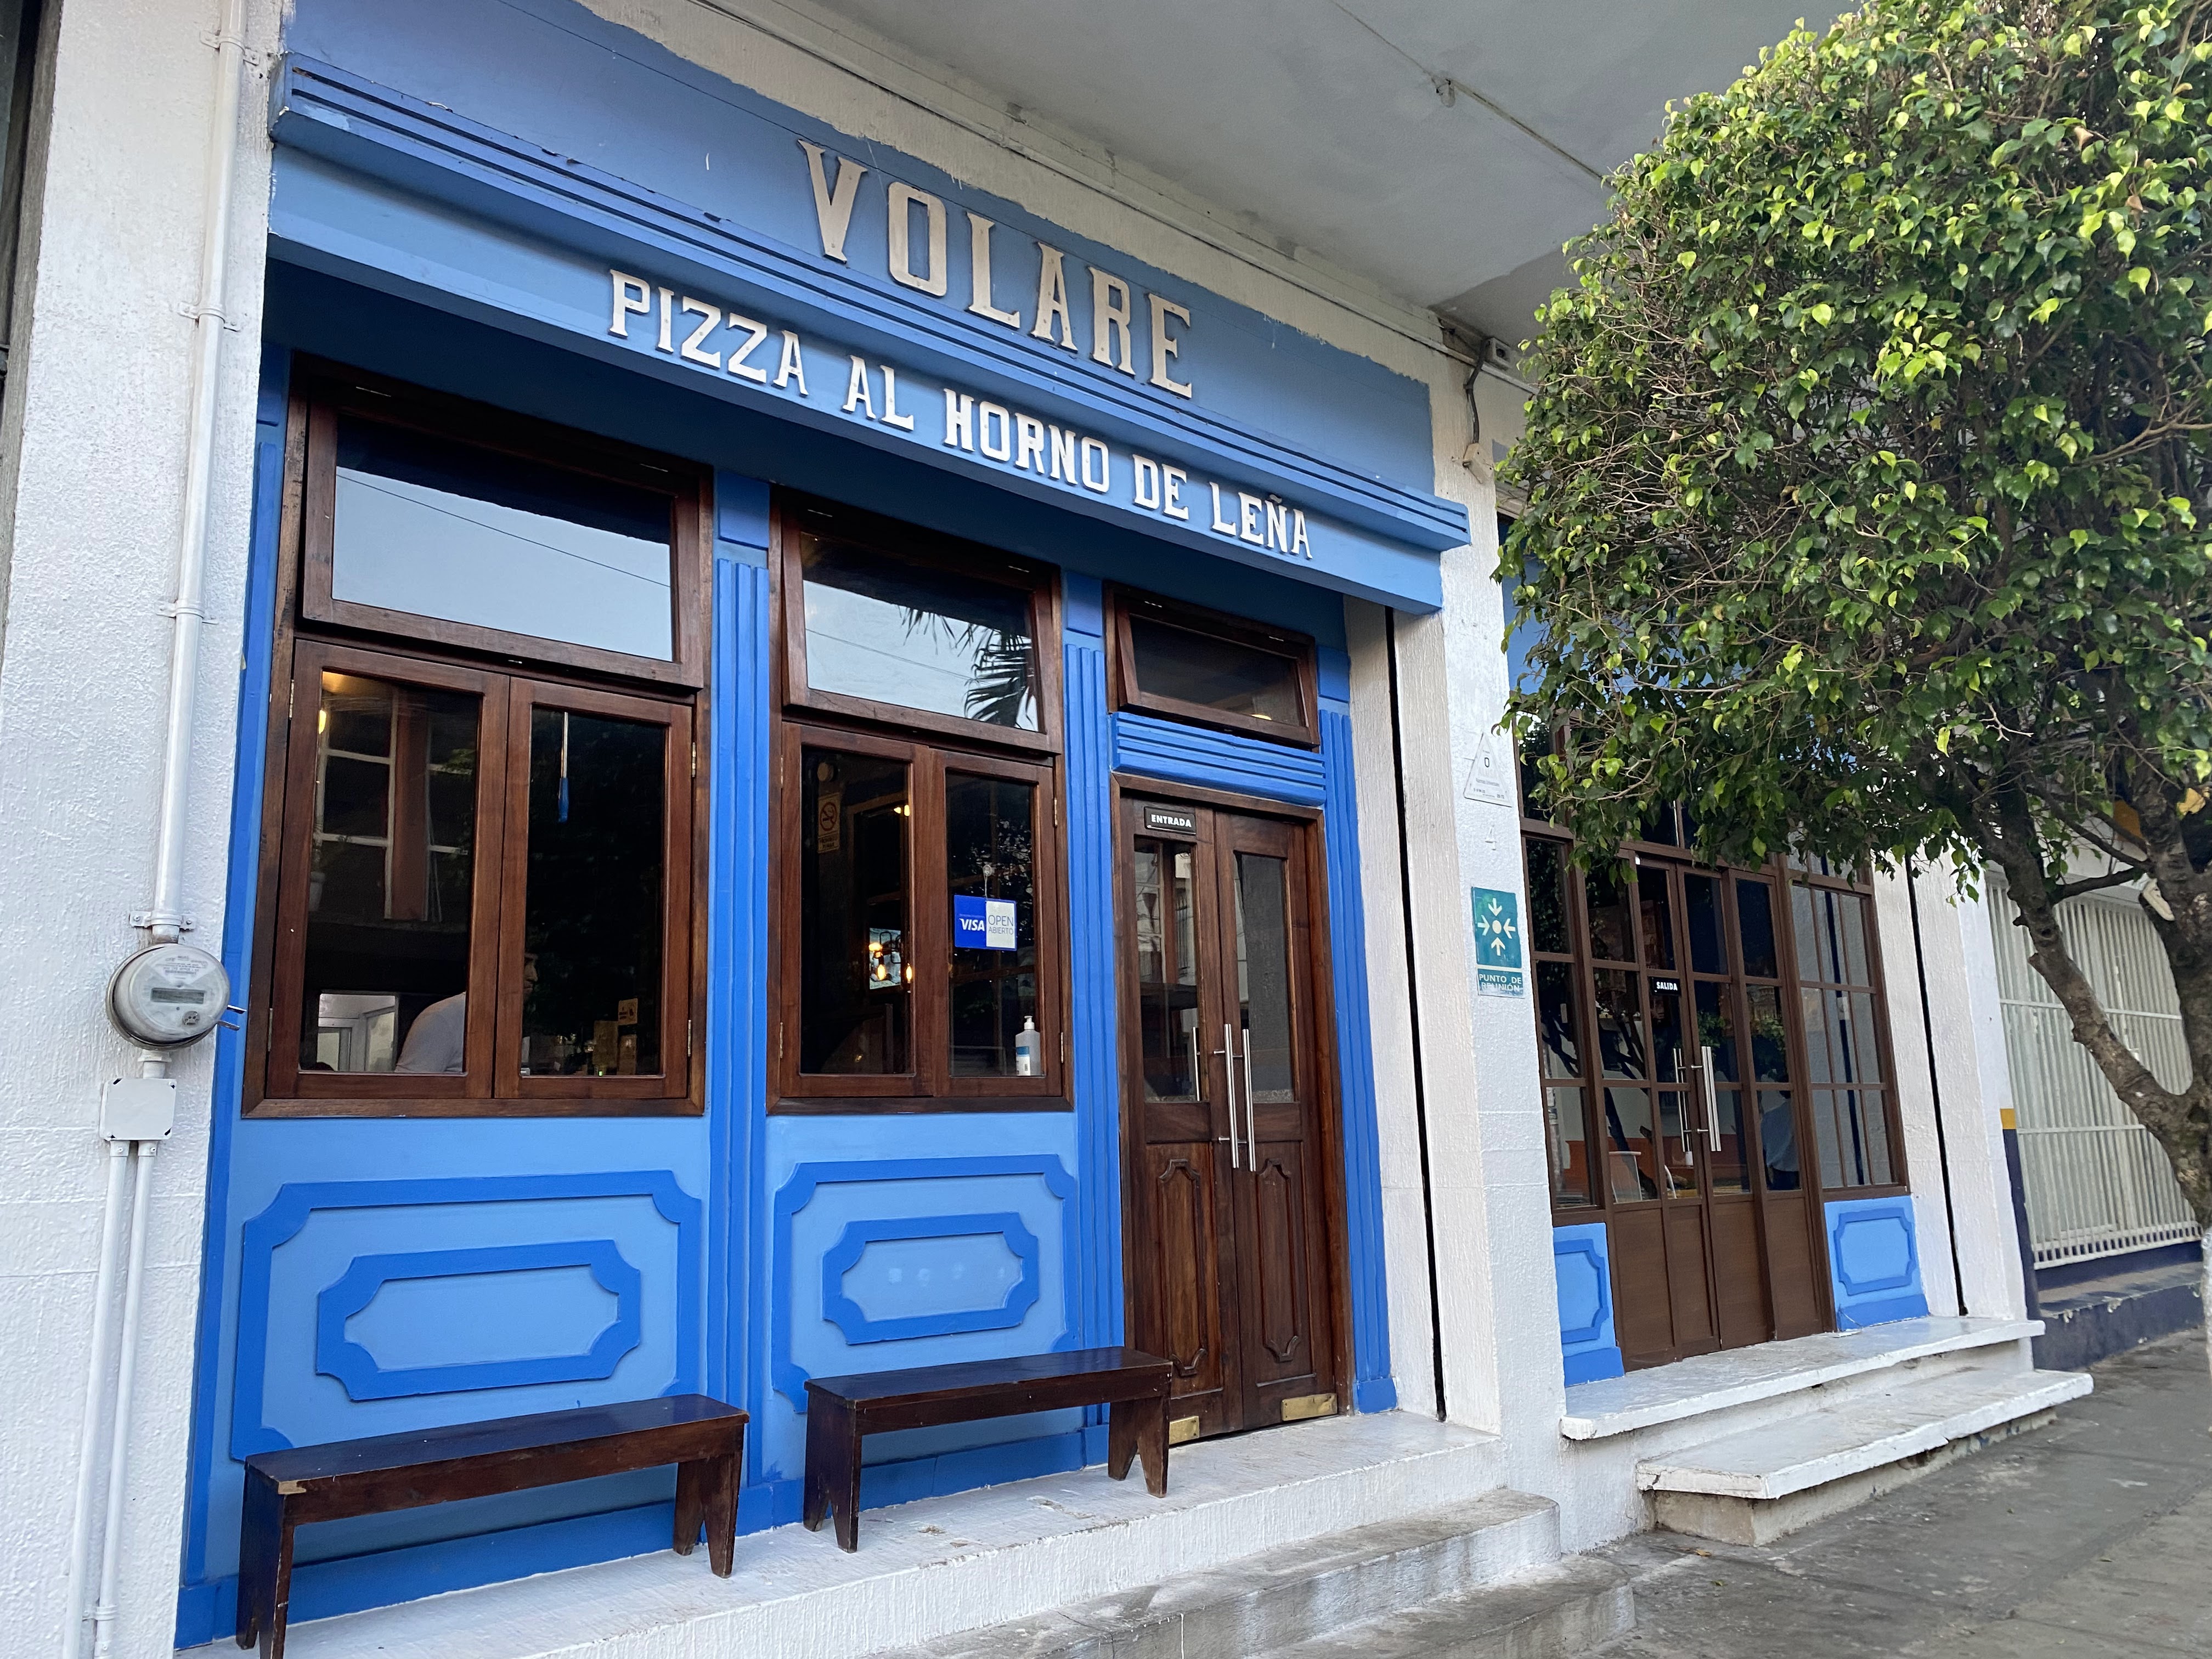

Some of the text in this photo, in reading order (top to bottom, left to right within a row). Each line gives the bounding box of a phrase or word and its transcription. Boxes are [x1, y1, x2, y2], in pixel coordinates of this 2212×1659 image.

[798, 139, 1192, 398] VOLARE
[608, 269, 1313, 559] PIZZA AL HORNO DE LEÑA
[1151, 814, 1192, 827] ENTRADA
[959, 918, 985, 932] VISA
[988, 915, 1014, 927] OPEN
[988, 927, 1014, 935] ABIERTO
[1479, 974, 1507, 983] PUNTO
[1656, 981, 1678, 991] SALIDA
